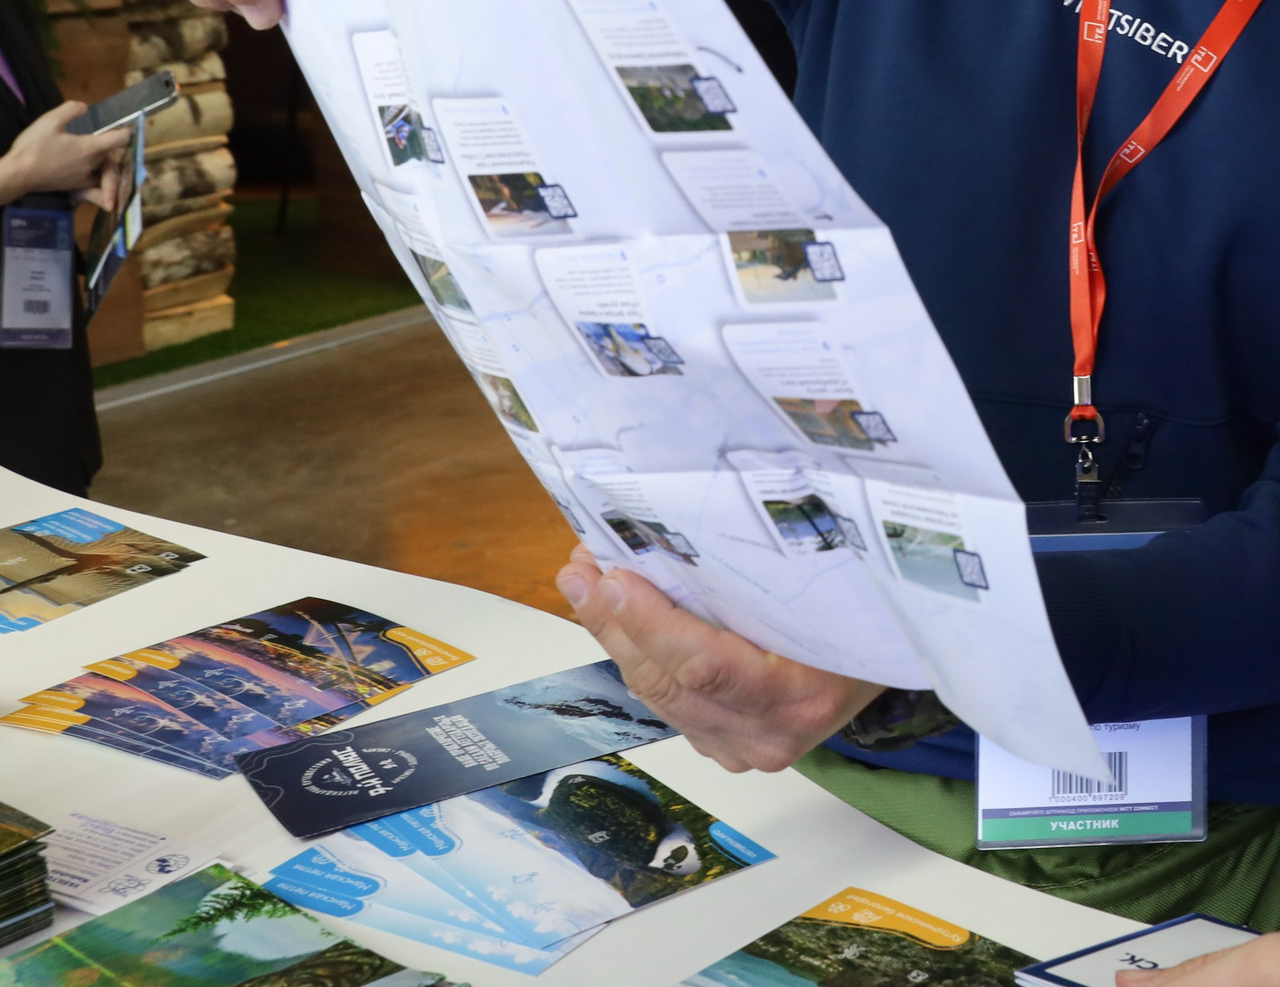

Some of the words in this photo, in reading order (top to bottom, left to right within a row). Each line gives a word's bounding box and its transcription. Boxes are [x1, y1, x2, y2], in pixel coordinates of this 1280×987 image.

[1104, 723, 1141, 733] туризму
[1050, 819, 1119, 831] УЧАСТНИК
[292, 863, 325, 876] петля
[276, 882, 309, 893] петля
[325, 873, 373, 891] Манская
[308, 892, 357, 910] Манская
